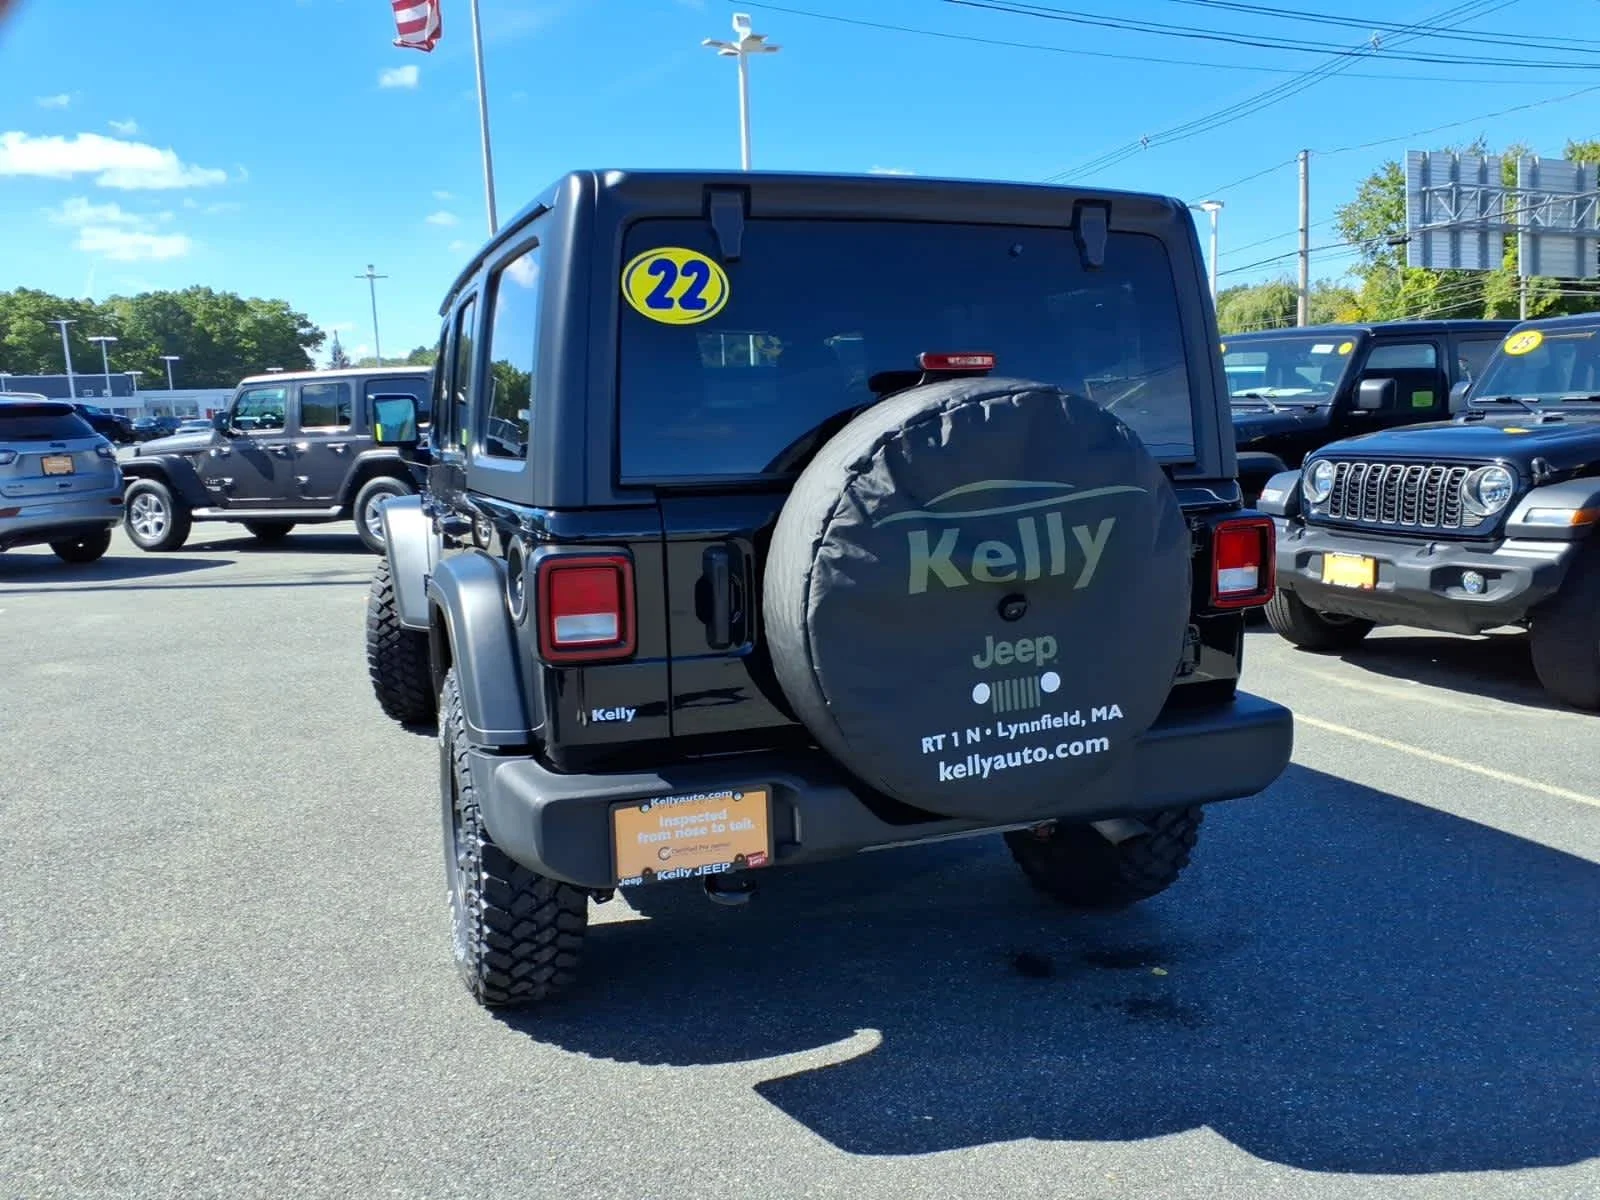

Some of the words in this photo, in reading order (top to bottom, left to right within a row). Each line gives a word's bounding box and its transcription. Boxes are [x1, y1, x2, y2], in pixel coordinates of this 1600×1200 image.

[645, 258, 711, 310] 22
[907, 511, 1117, 595] Kelly
[972, 635, 1058, 669] Jeep
[592, 706, 636, 722] Kelly
[922, 734, 946, 754] RT
[951, 731, 959, 747] 1
[966, 727, 981, 745] N
[997, 710, 1087, 740] Lynnfield,
[1091, 704, 1124, 723] MA
[939, 736, 1110, 782] kellyauto.com
[650, 790, 733, 807] Kellyauto.com
[659, 808, 728, 829] Inspected
[637, 831, 672, 844] from
[675, 825, 708, 839] nose
[711, 822, 726, 833] to
[618, 876, 643, 887] Jeep
[657, 868, 692, 881] Kelly
[695, 861, 731, 876] JEEP
